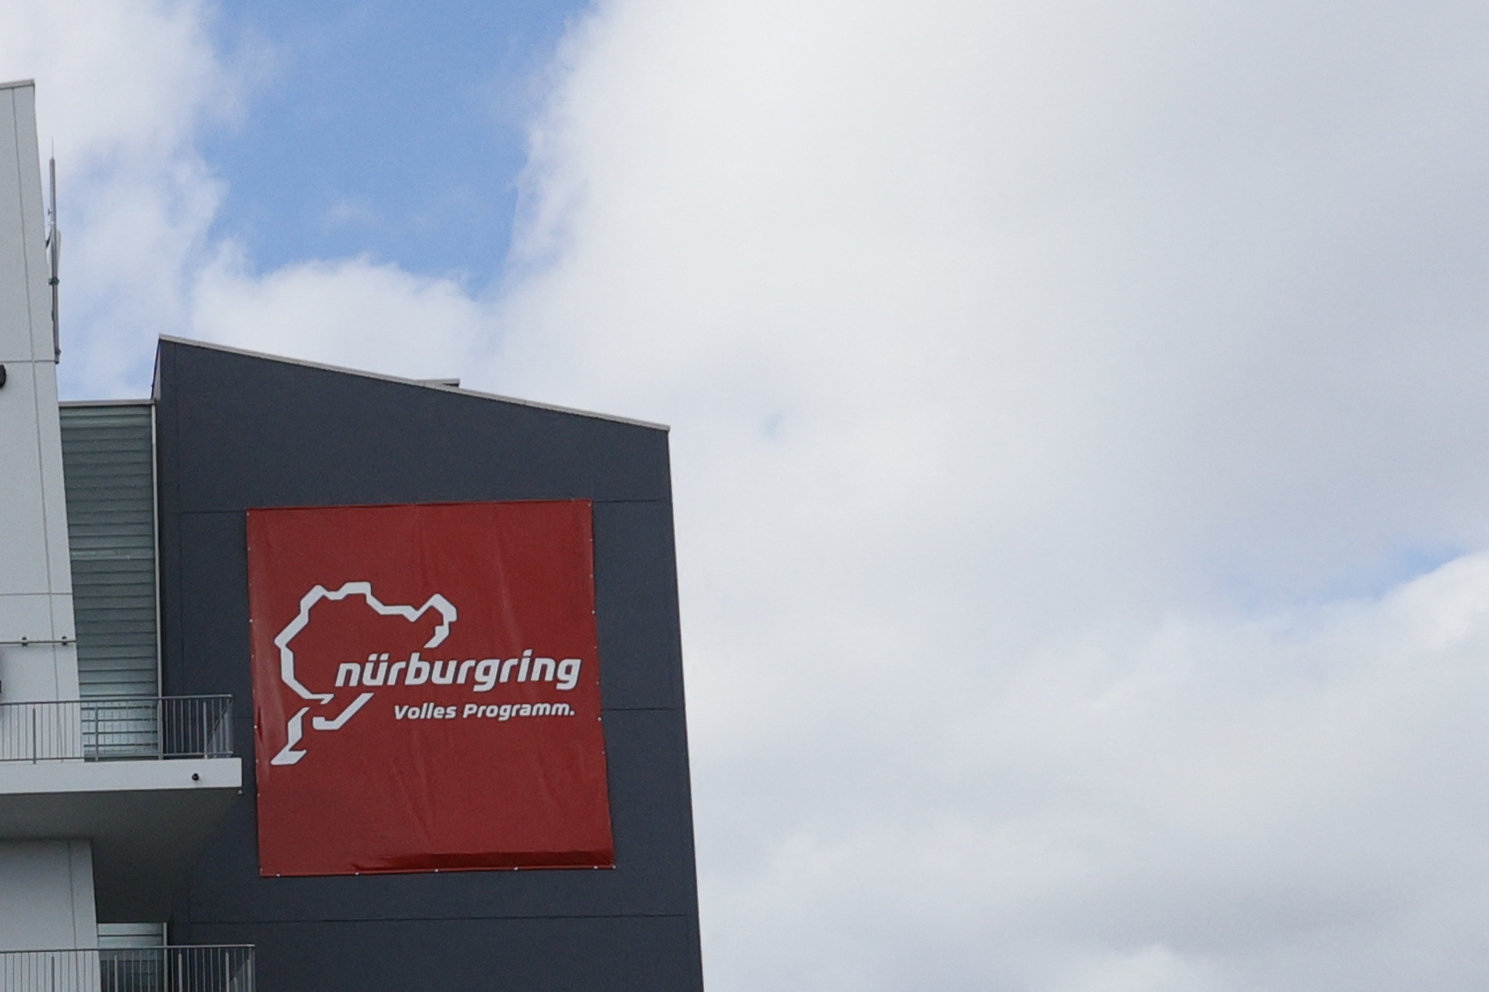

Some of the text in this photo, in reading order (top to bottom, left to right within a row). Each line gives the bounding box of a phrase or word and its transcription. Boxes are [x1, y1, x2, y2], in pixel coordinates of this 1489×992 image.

[335, 649, 582, 692] nürburgring
[394, 701, 576, 722] Volles Programm.
